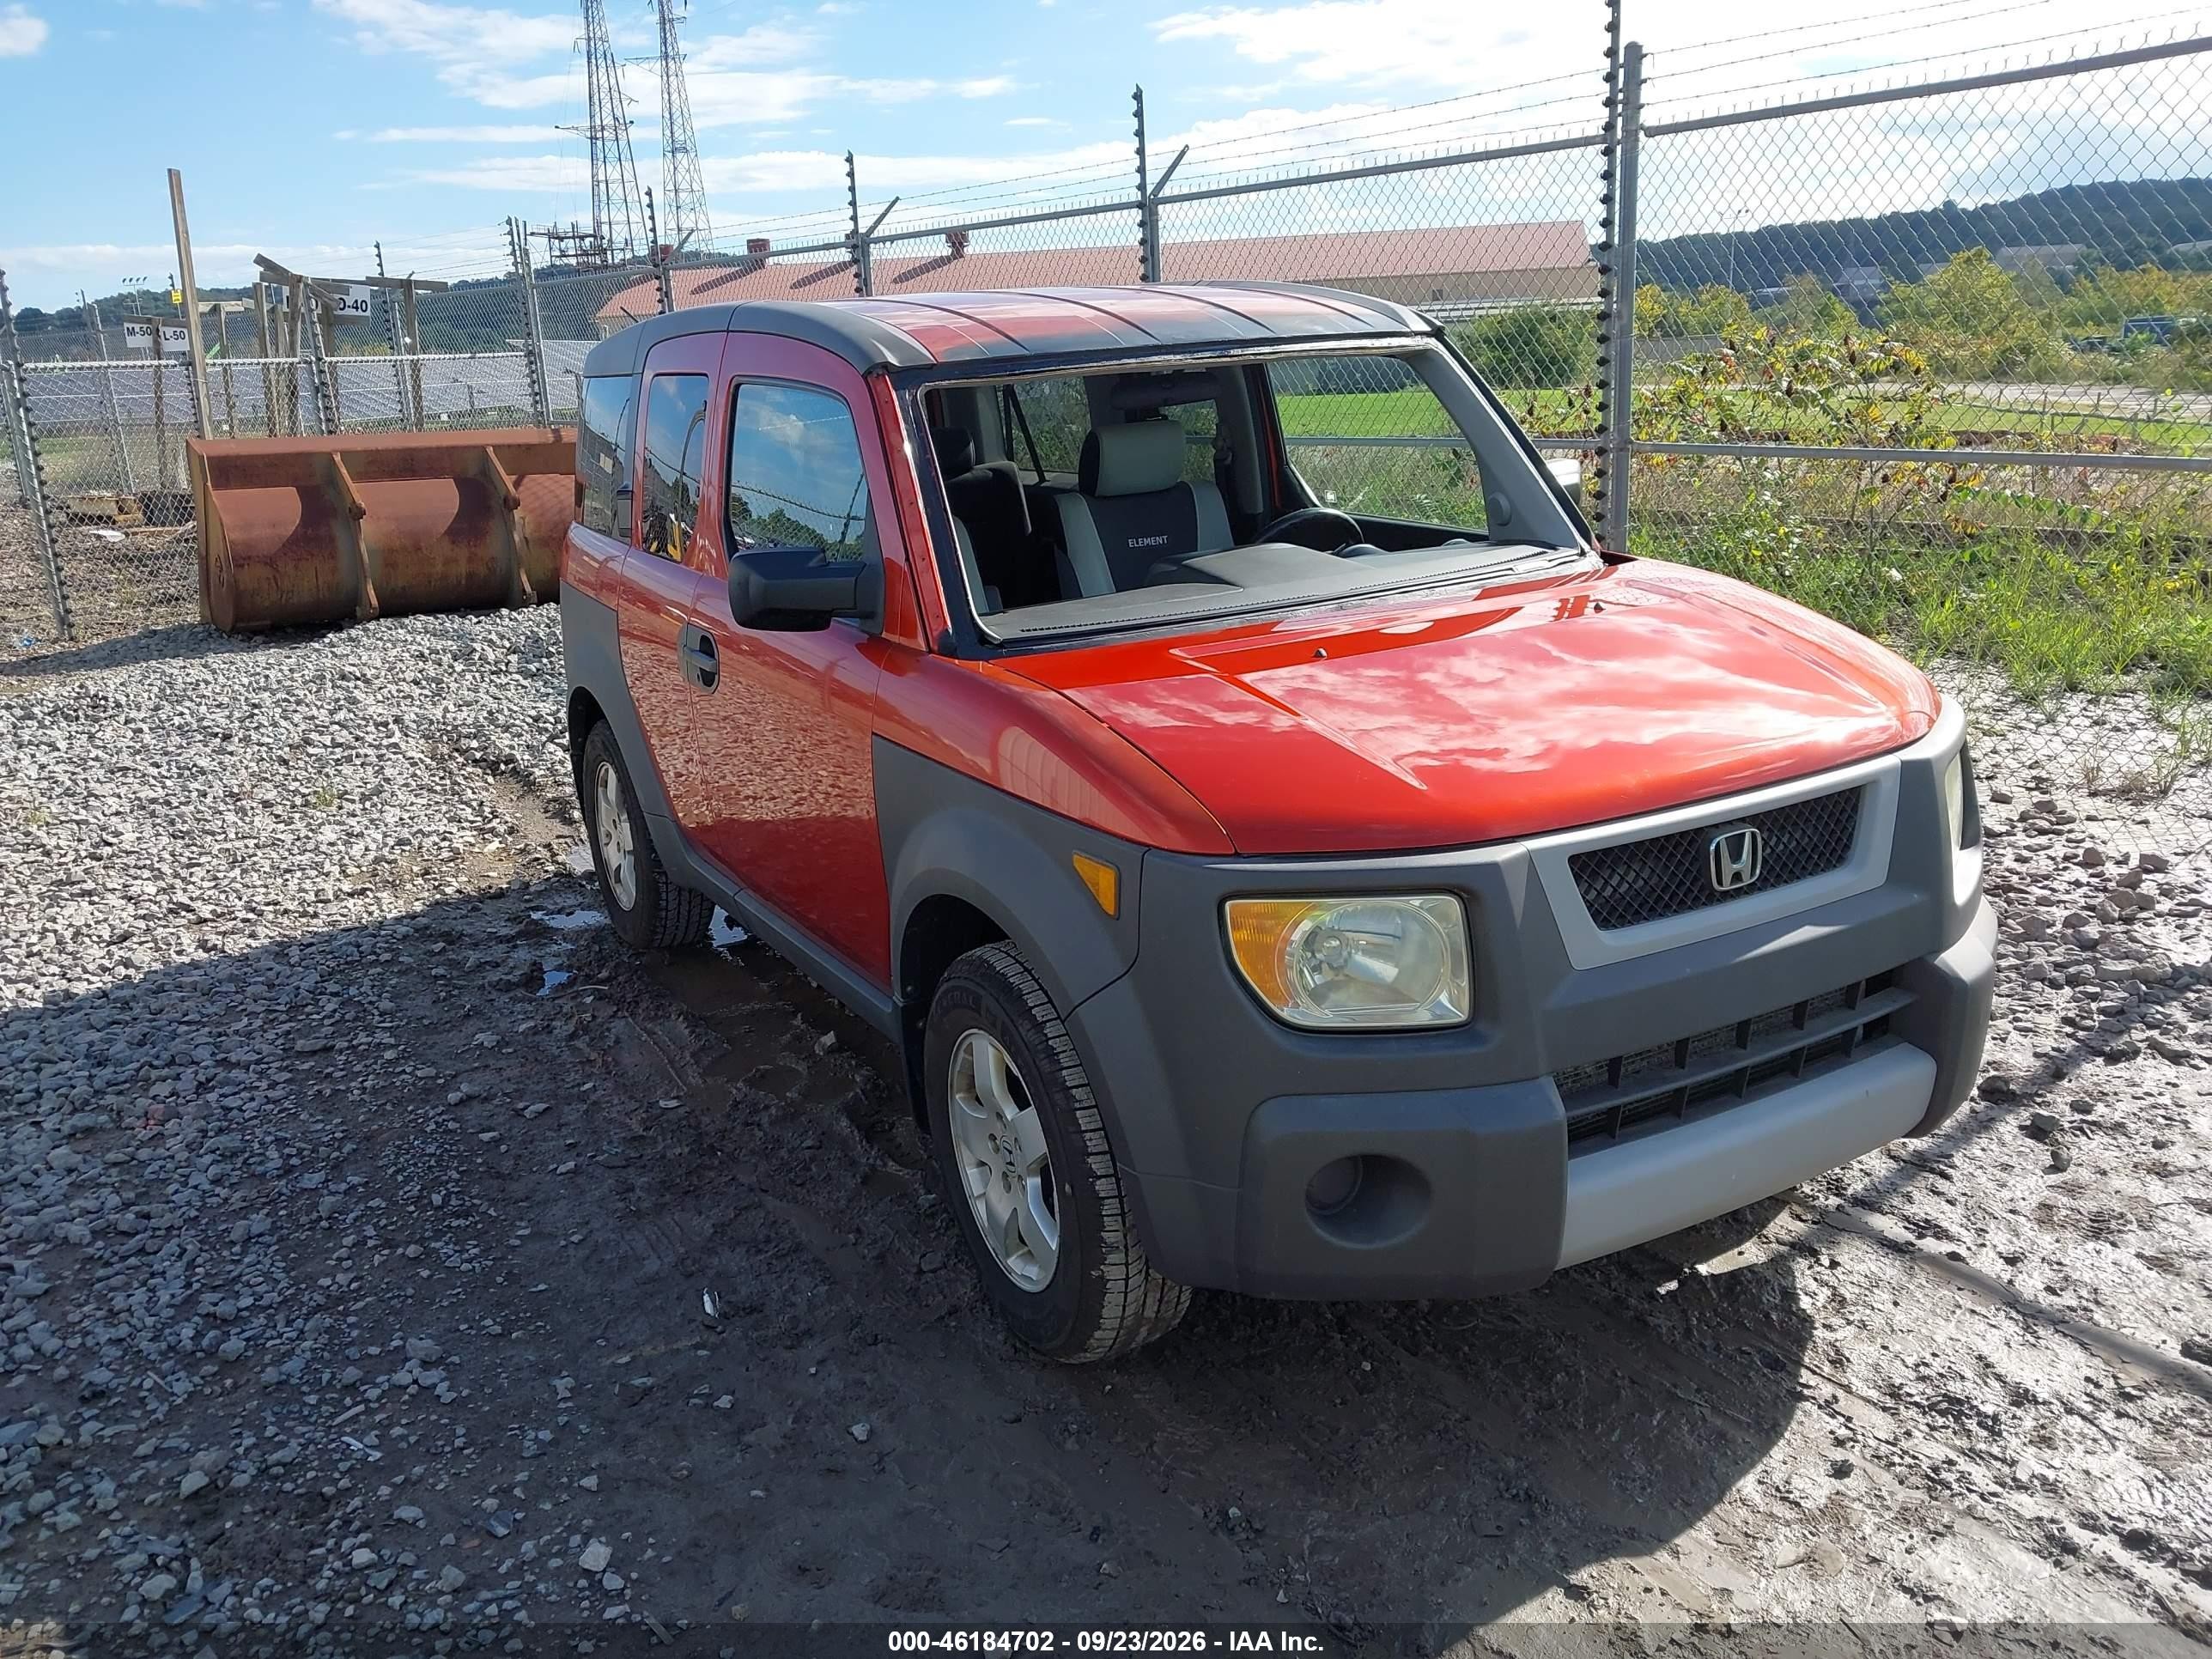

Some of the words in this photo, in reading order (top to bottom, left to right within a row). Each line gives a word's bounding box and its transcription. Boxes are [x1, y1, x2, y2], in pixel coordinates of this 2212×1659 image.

[125, 326, 153, 337] M-50
[162, 330, 186, 341] L-50
[1127, 535, 1169, 548] ELEMENT
